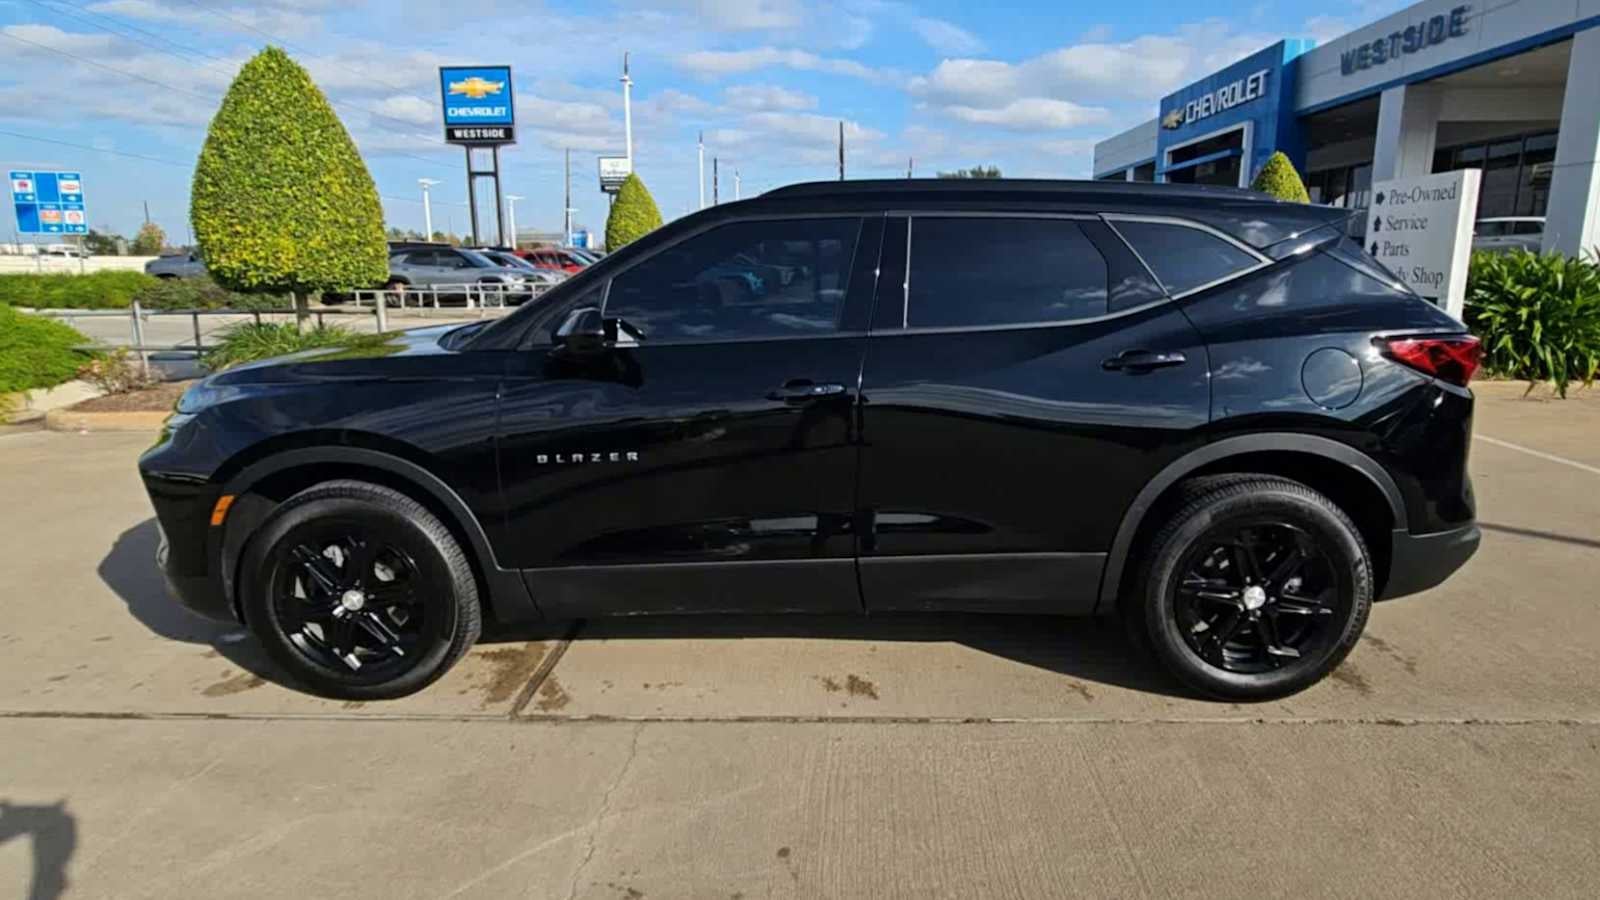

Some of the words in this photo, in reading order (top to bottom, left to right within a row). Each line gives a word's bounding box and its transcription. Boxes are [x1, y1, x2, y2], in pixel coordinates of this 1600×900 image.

[1340, 5, 1471, 76] WESTSIDE
[1185, 68, 1269, 124] CHEVROLET
[447, 107, 506, 116] CHEVROLET
[453, 129, 505, 138] WESTSIDE
[1389, 182, 1457, 205] Pre-Owned
[1384, 215, 1428, 232] Service
[1382, 241, 1409, 256] Parts
[1411, 265, 1444, 289] Shop
[536, 452, 638, 463] BLAZER
